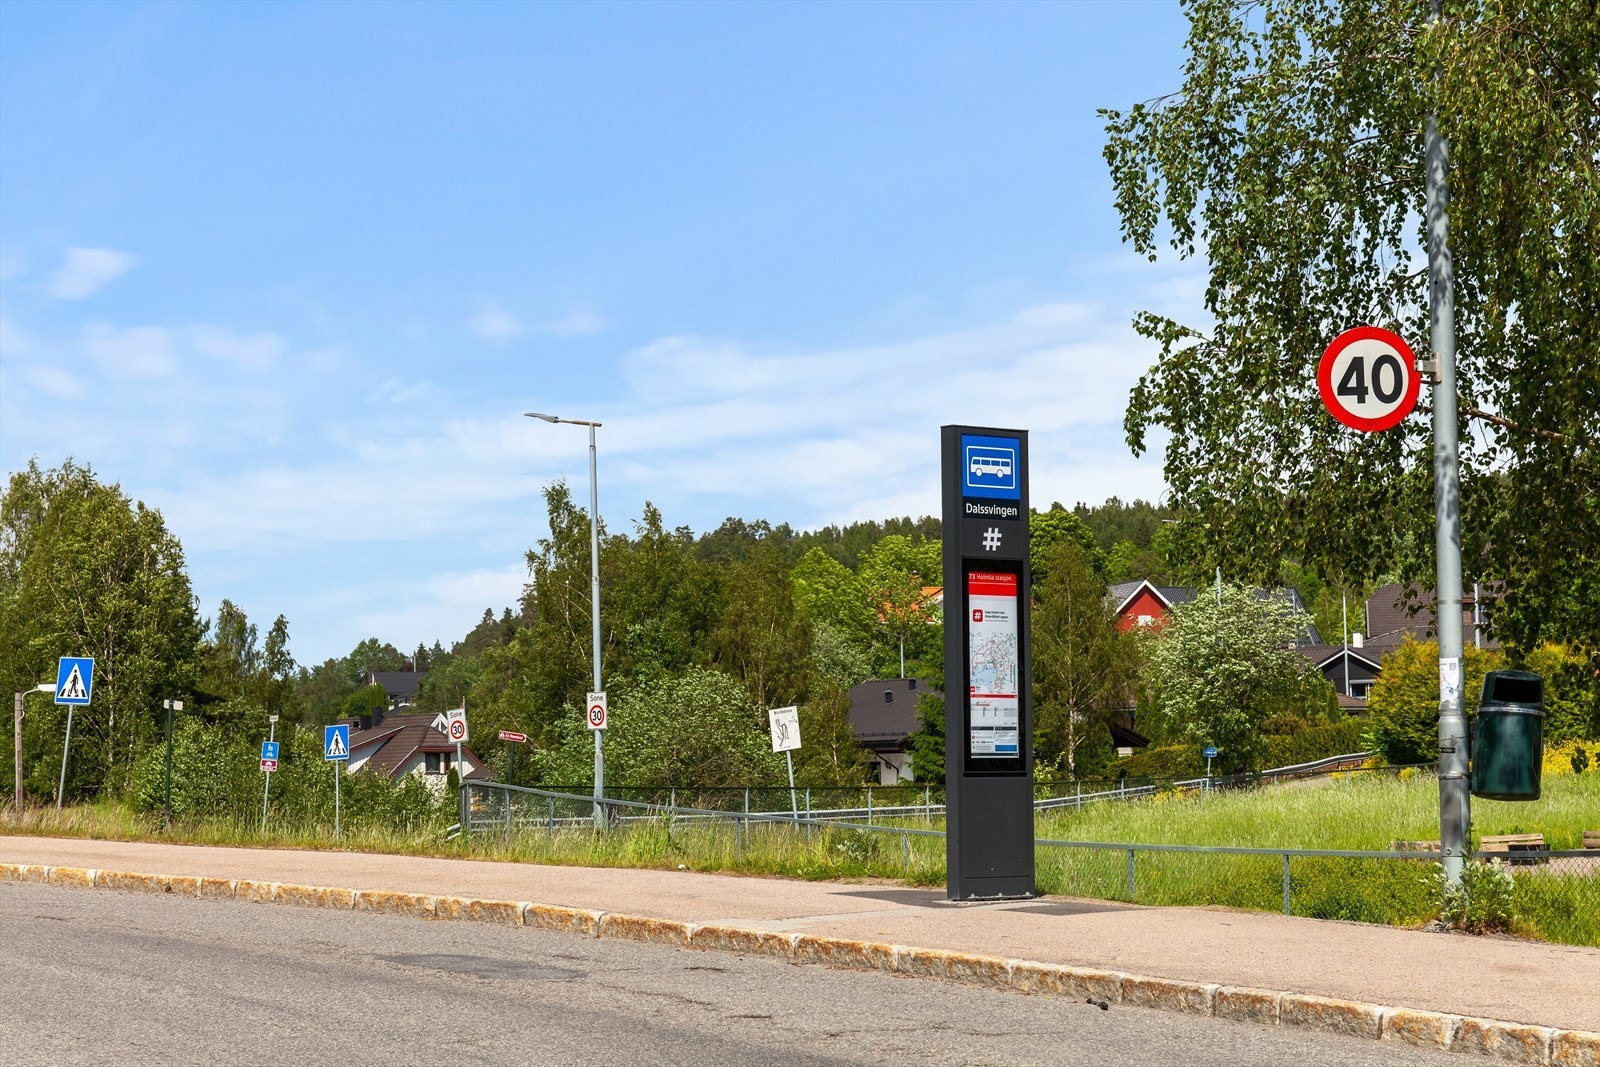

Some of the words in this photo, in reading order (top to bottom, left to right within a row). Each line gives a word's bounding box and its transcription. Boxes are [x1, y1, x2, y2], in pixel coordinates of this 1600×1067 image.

[1337, 354, 1403, 404] 40
[965, 503, 1018, 517] Dalssvingen
[590, 694, 603, 702] Sone
[449, 711, 462, 719] Sone
[592, 710, 602, 721] 30
[453, 724, 463, 735] 30
